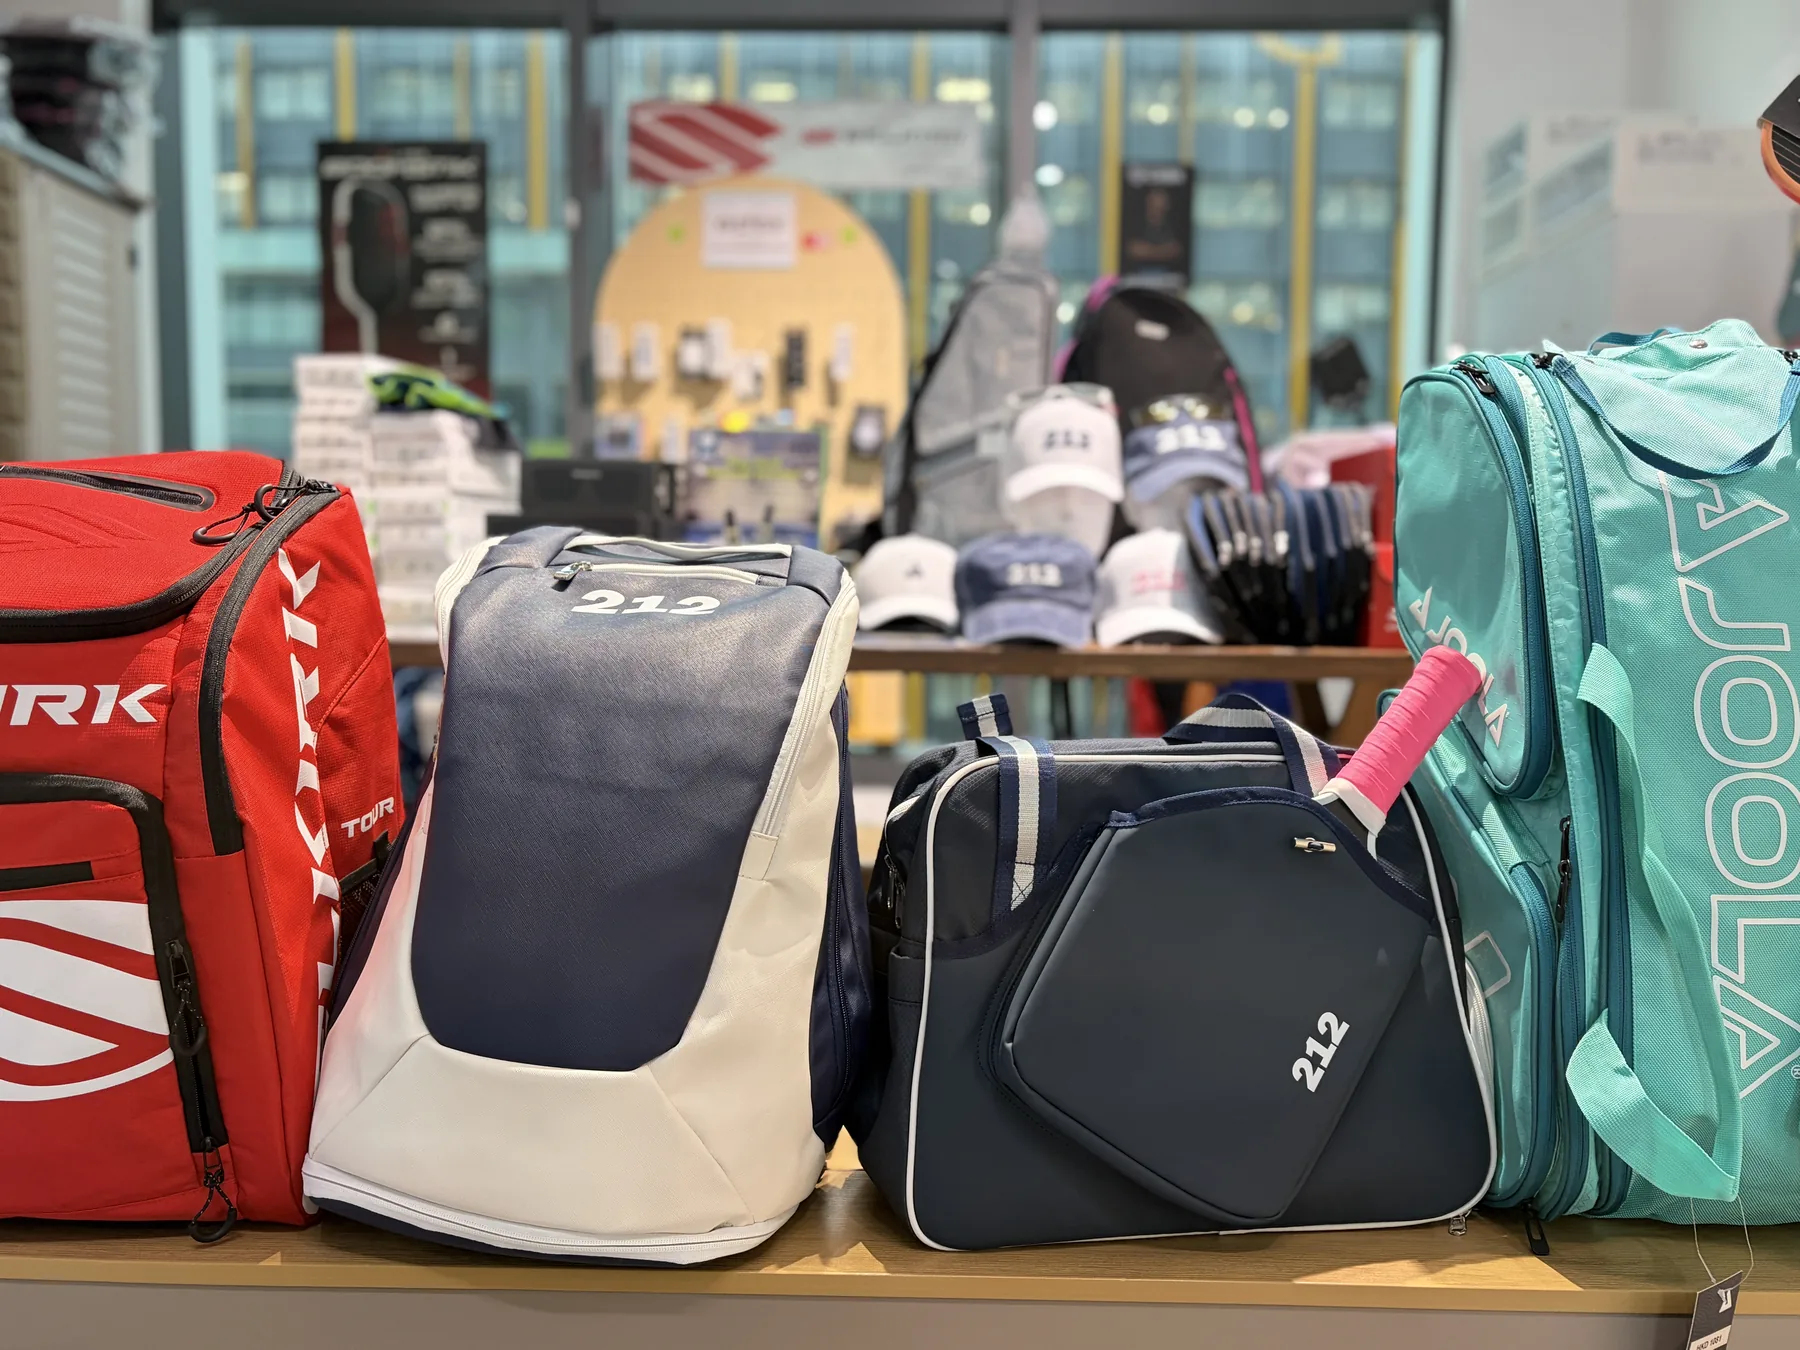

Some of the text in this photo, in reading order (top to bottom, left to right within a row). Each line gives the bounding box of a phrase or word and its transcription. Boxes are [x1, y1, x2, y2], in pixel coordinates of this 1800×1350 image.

[570, 589, 721, 616] 212
[340, 795, 396, 839] TOUR
[1291, 1011, 1350, 1093] 212
